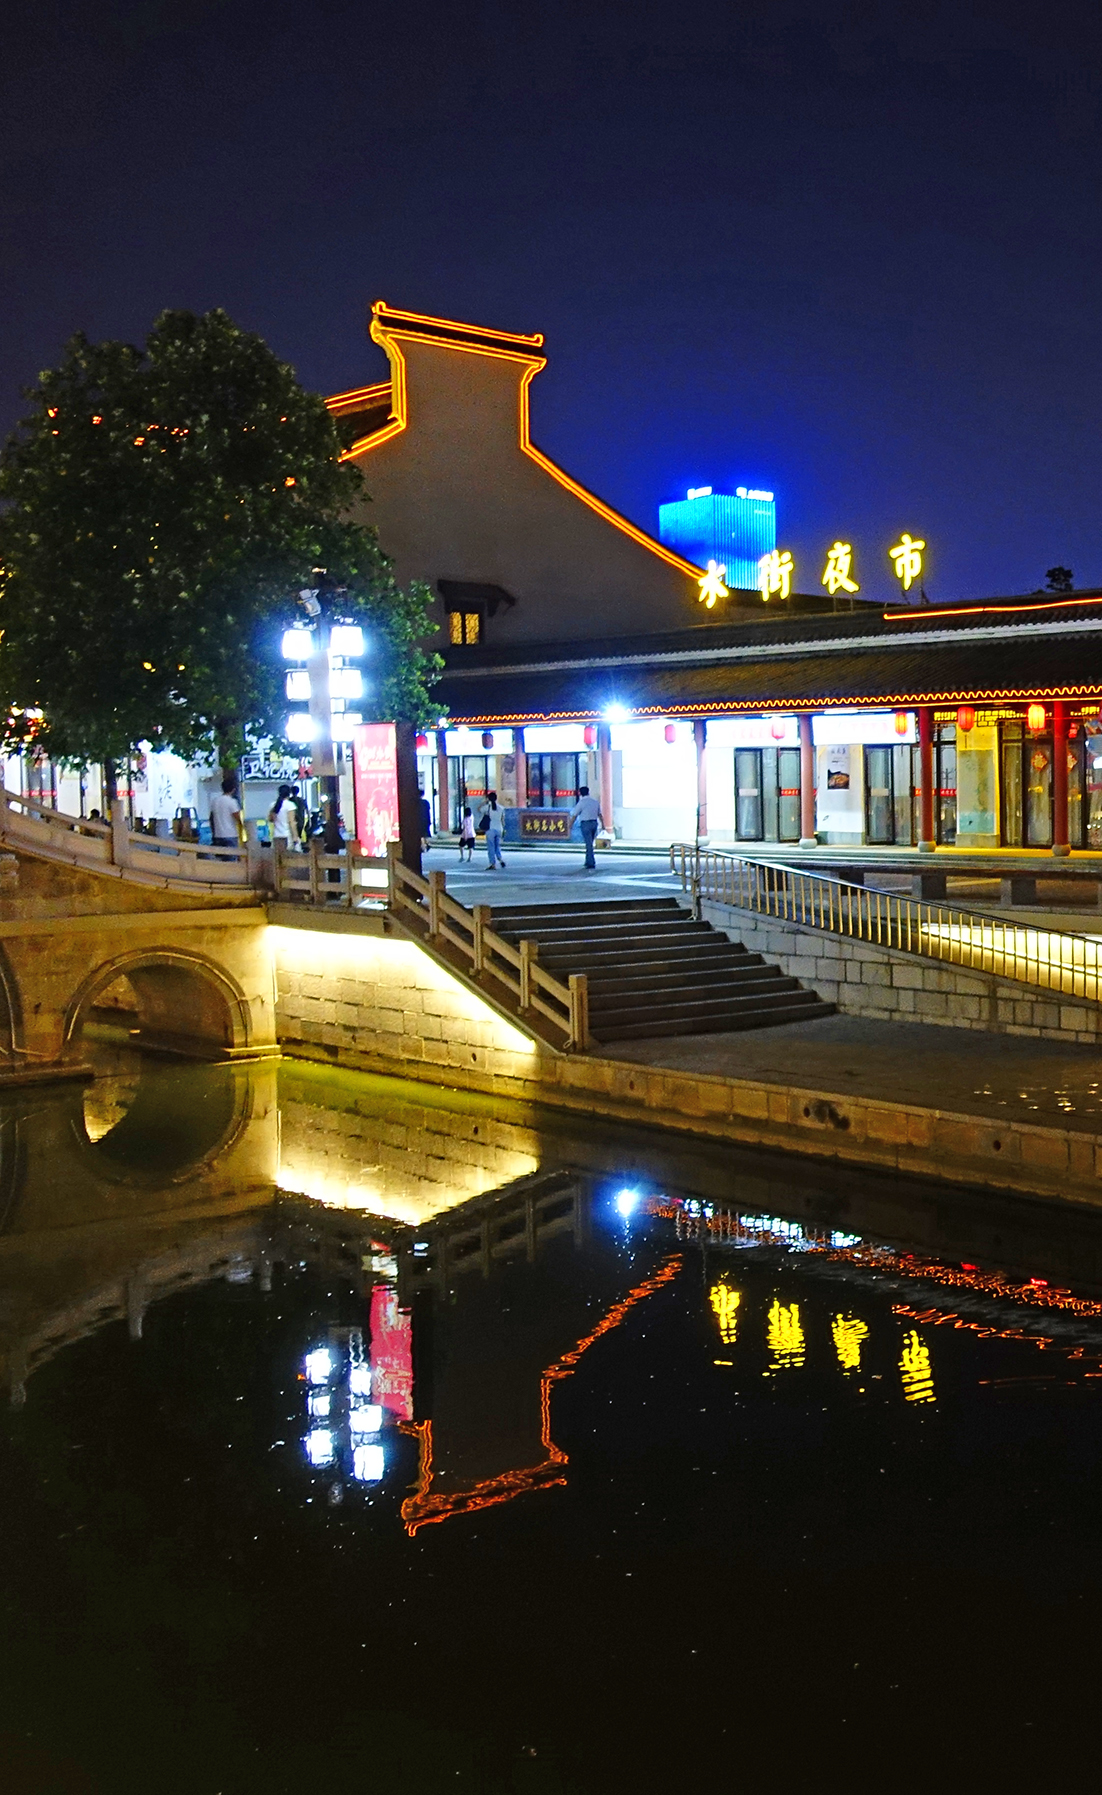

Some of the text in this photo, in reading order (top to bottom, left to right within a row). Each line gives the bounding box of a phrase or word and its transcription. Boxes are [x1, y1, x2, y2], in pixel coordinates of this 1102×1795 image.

[698, 533, 925, 609] 水街夜市
[526, 819, 566, 833] 水街名小吃
